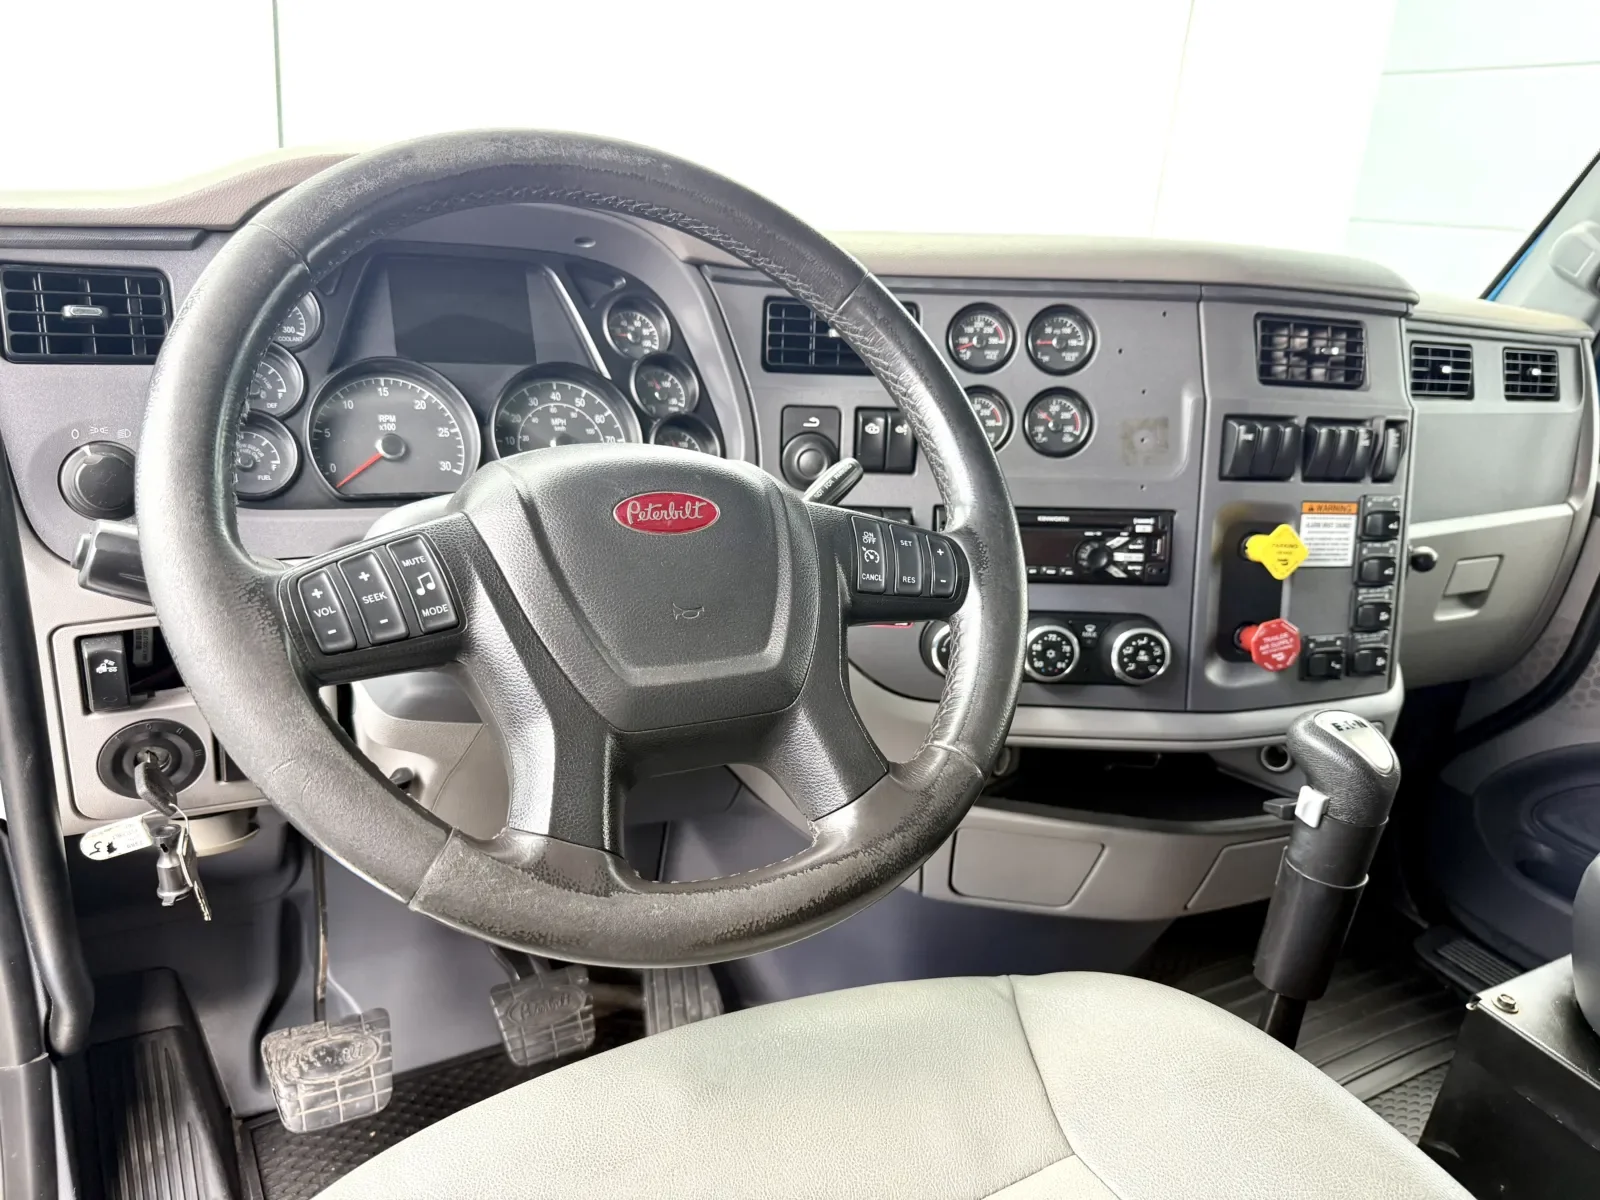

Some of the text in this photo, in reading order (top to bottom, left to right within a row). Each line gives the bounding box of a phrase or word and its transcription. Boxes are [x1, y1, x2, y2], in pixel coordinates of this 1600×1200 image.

[378, 388, 389, 397] 15
[550, 392, 561, 401] 40
[343, 401, 353, 409] 10
[414, 401, 426, 410] 20
[528, 398, 538, 406] 30
[575, 398, 585, 407] 50
[510, 414, 521, 423] 20
[595, 414, 605, 424] 60
[324, 429, 331, 438] 5
[438, 428, 449, 437] 25
[505, 436, 515, 445] 10
[330, 464, 336, 473] 0
[440, 462, 451, 471] 30
[627, 500, 707, 525] Peterbilt
[1316, 504, 1352, 512] WARNING
[402, 556, 426, 567] MUTE
[862, 573, 882, 581] CANCL
[362, 592, 388, 604] SEEK
[313, 607, 336, 618] VOL
[421, 604, 449, 617] MODE
